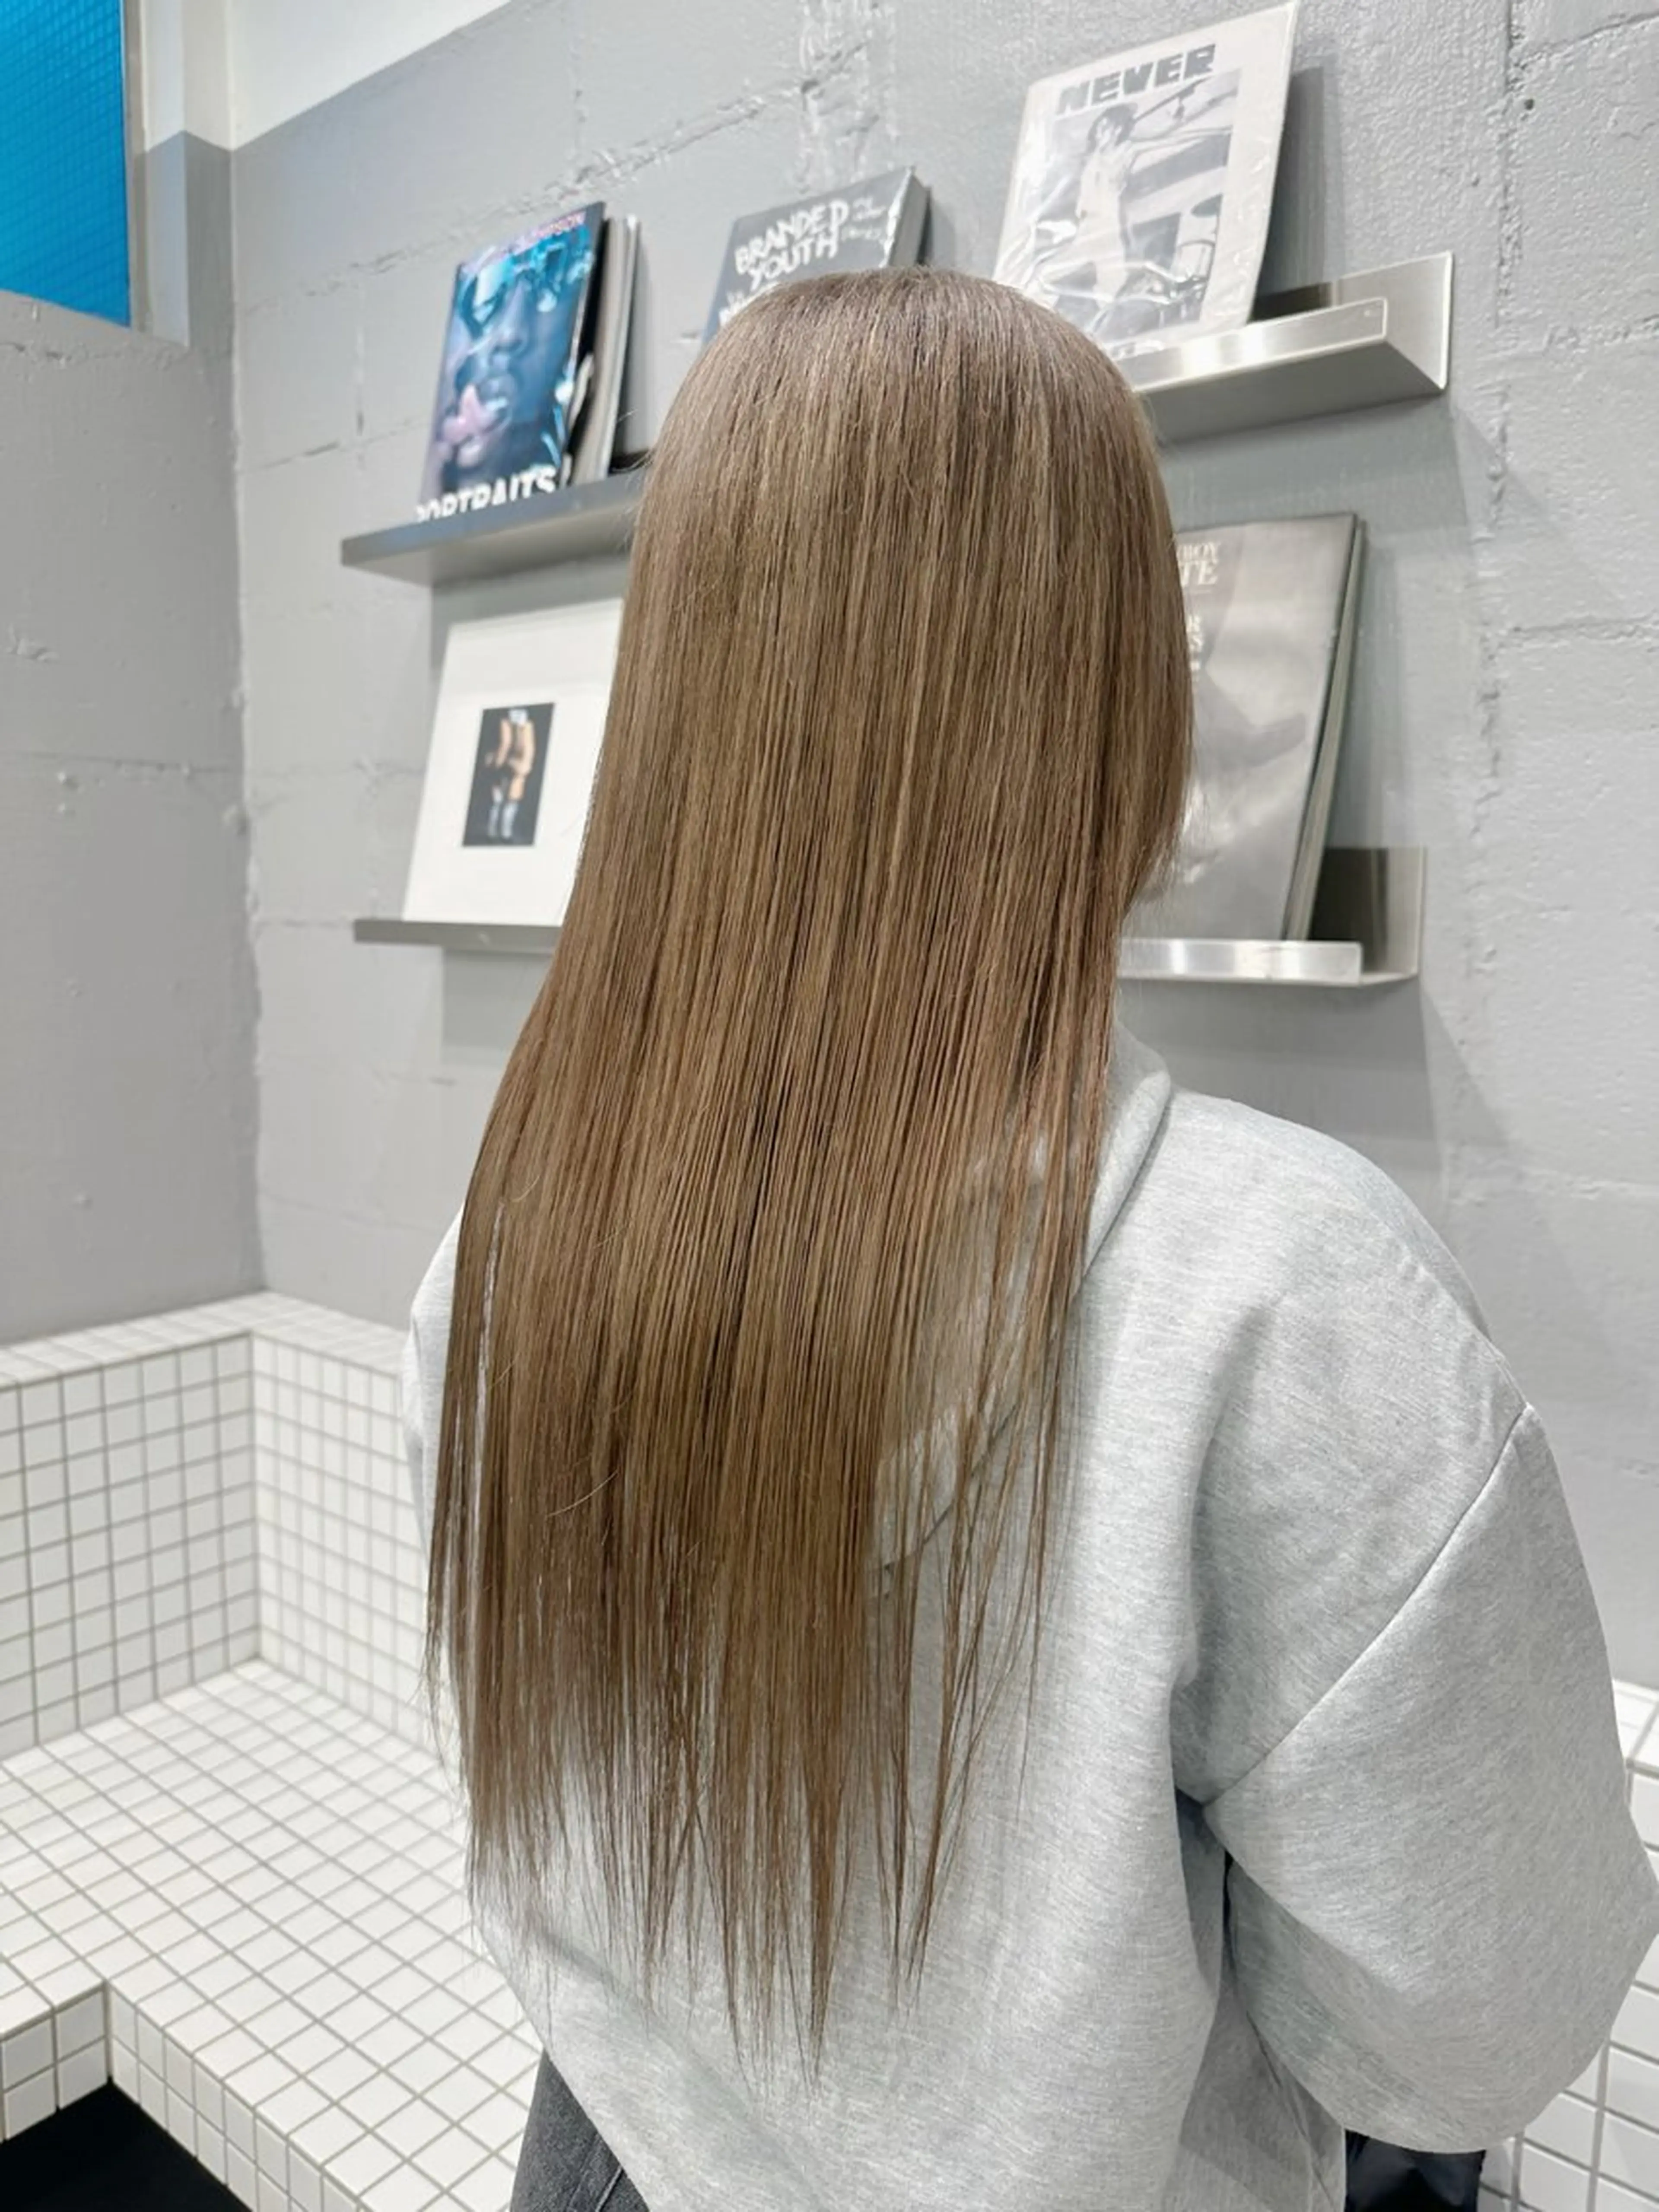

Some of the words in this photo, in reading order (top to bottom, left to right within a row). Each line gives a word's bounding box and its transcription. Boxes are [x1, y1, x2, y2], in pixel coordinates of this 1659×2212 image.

[1057, 44, 1215, 114] NEVER
[735, 199, 849, 275] BRANDED
[749, 230, 838, 291] YOUTH
